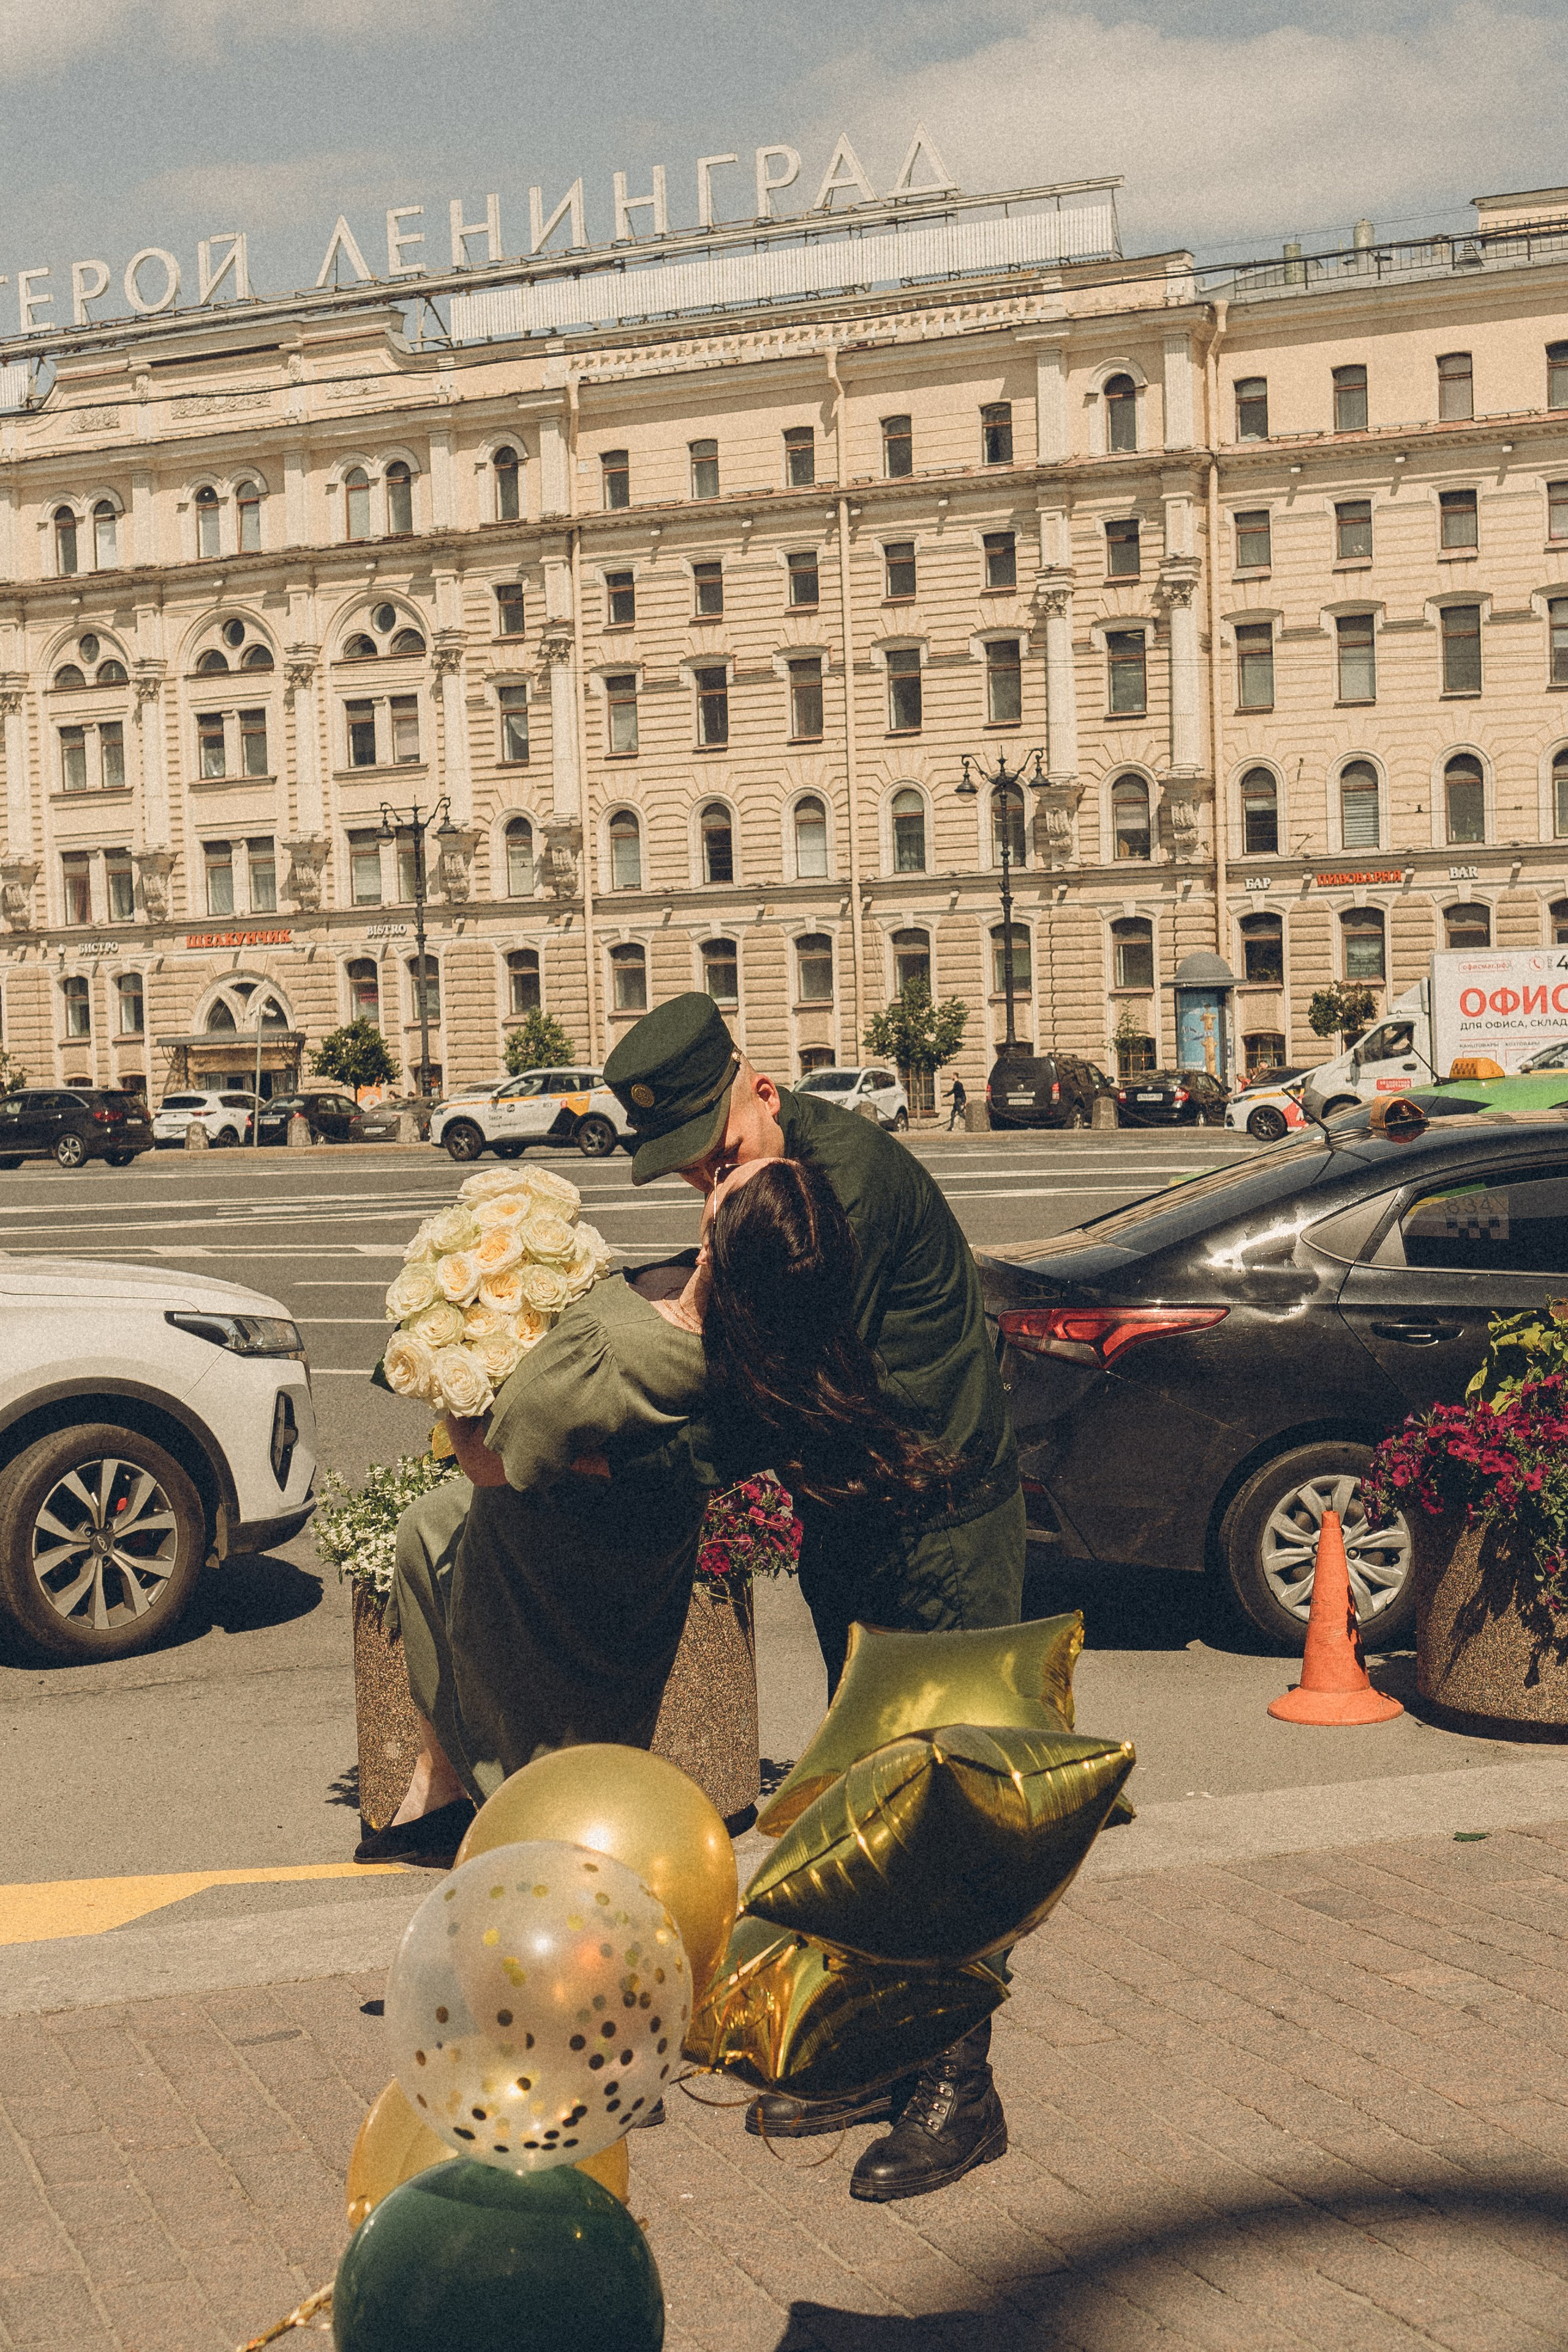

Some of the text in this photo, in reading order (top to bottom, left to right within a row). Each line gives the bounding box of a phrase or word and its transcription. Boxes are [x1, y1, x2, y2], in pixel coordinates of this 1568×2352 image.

[0, 122, 960, 336] ЕРОЙ ЛЕНИНГРАД
[1317, 870, 1401, 886] ПИВОВАРНЯ
[1449, 866, 1478, 878] BAR
[1245, 877, 1272, 889] БАР
[368, 924, 407, 936] BISTRO
[186, 929, 292, 948] ЩЕЛКУНЧИК
[78, 941, 119, 954] БИСТРО
[1463, 962, 1507, 971] офисмаг.рф
[1461, 1022, 1482, 1031] ДЛЯ
[1485, 1020, 1528, 1029] ОФИСА,
[1447, 1196, 1492, 1214] 834
